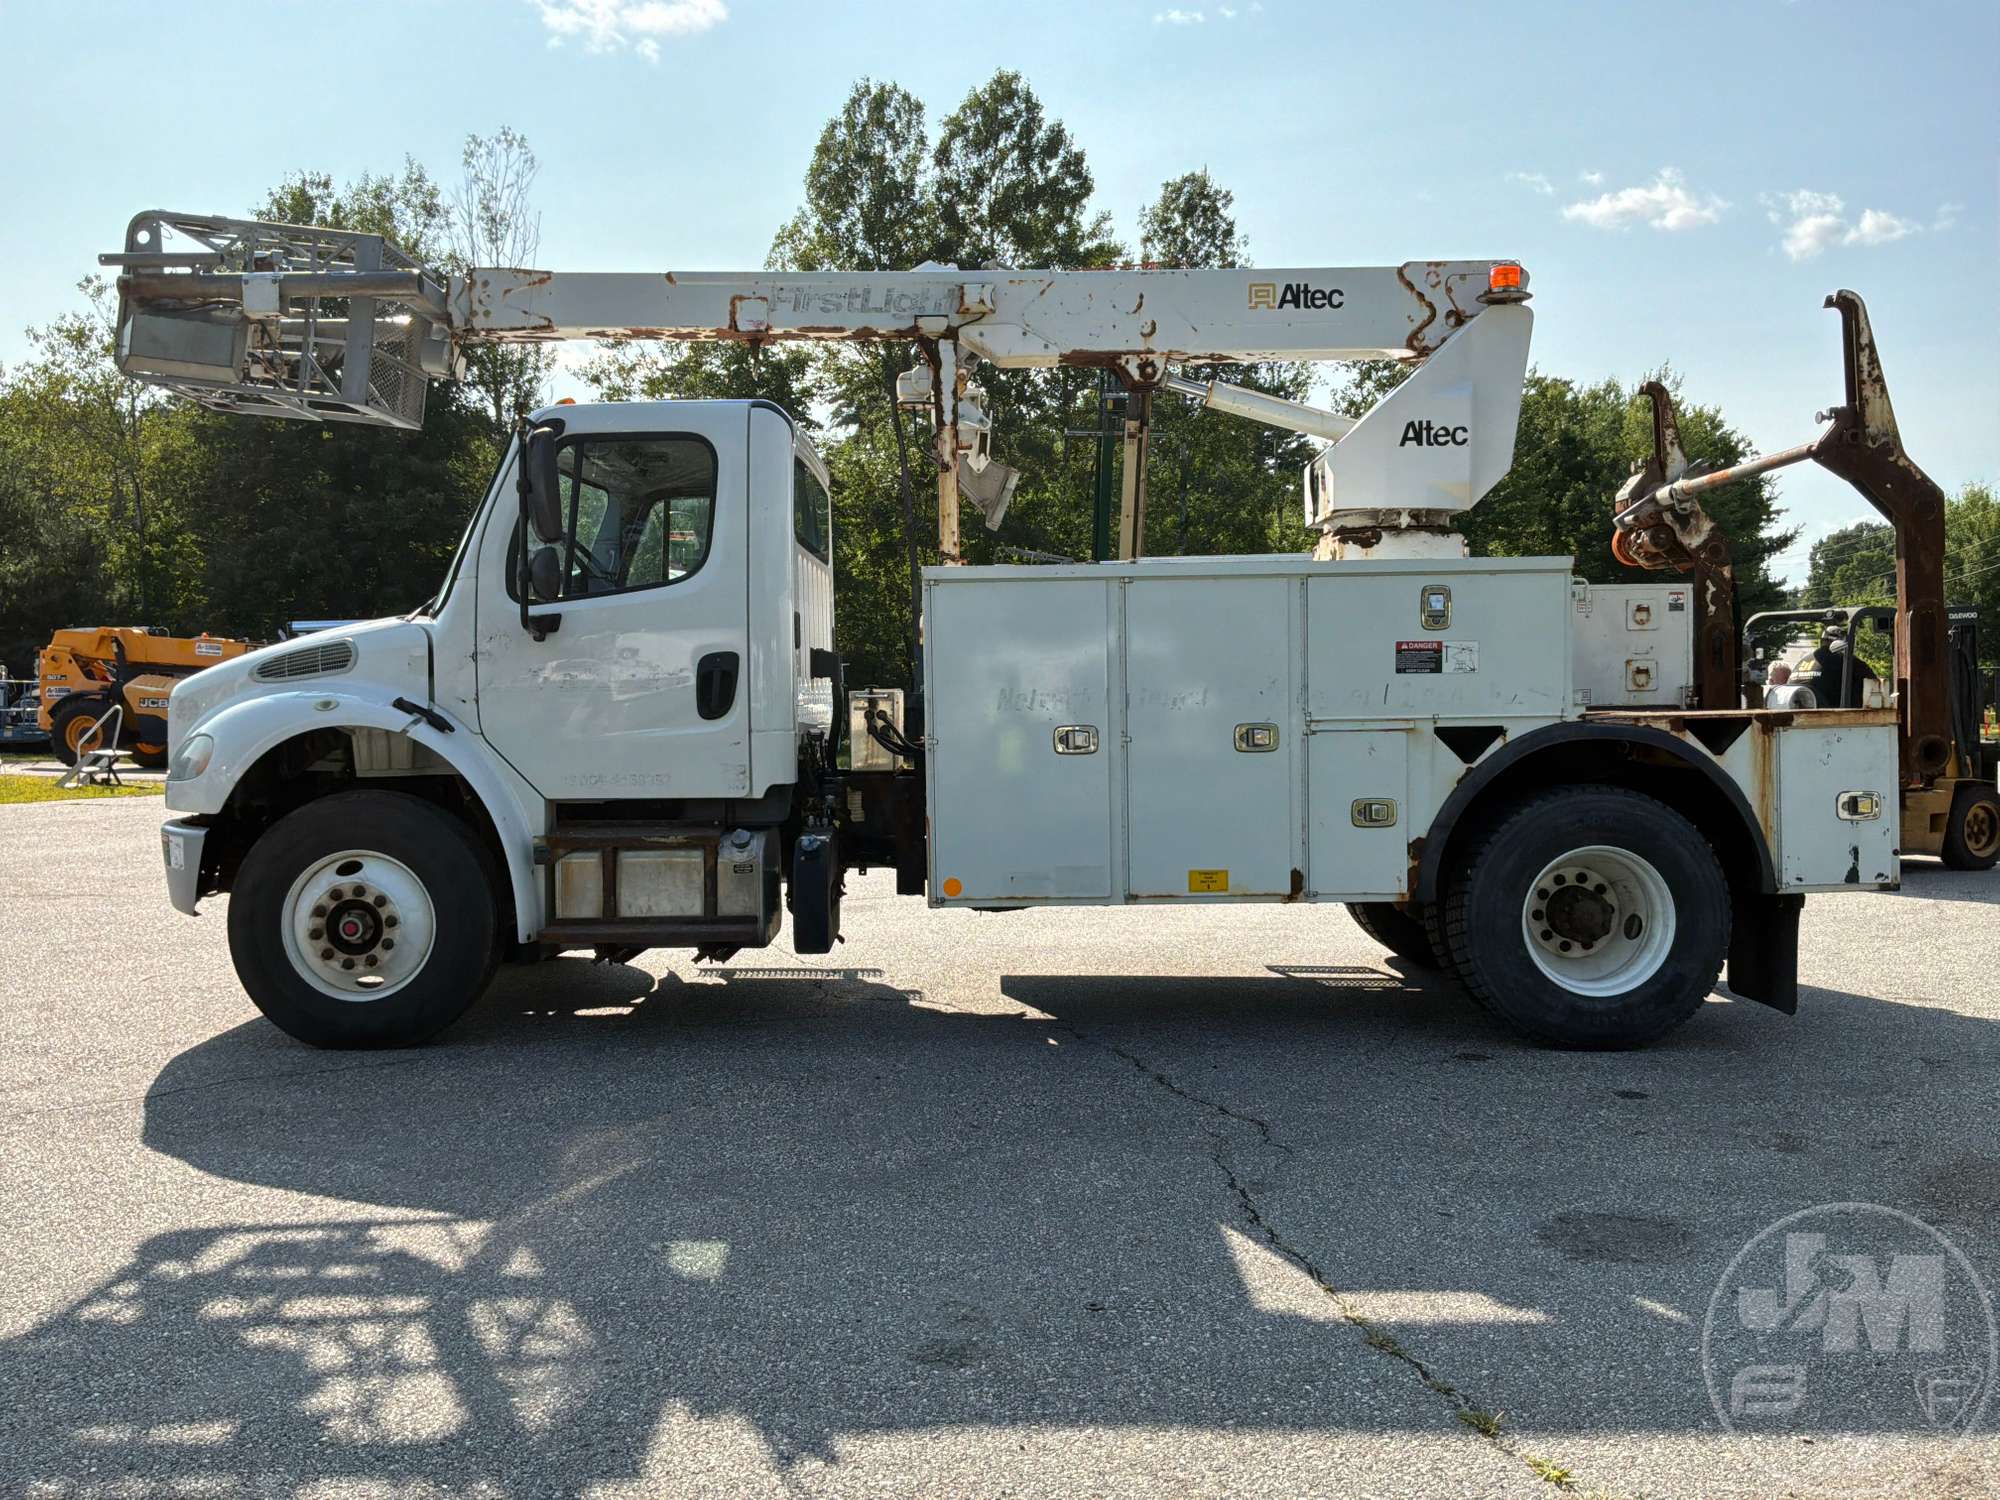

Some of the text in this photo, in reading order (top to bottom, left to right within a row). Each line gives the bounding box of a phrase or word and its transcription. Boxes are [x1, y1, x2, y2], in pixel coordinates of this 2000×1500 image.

[1278, 283, 1344, 309] Altec
[1399, 420, 1469, 446] Altec
[139, 699, 168, 708] JCB
